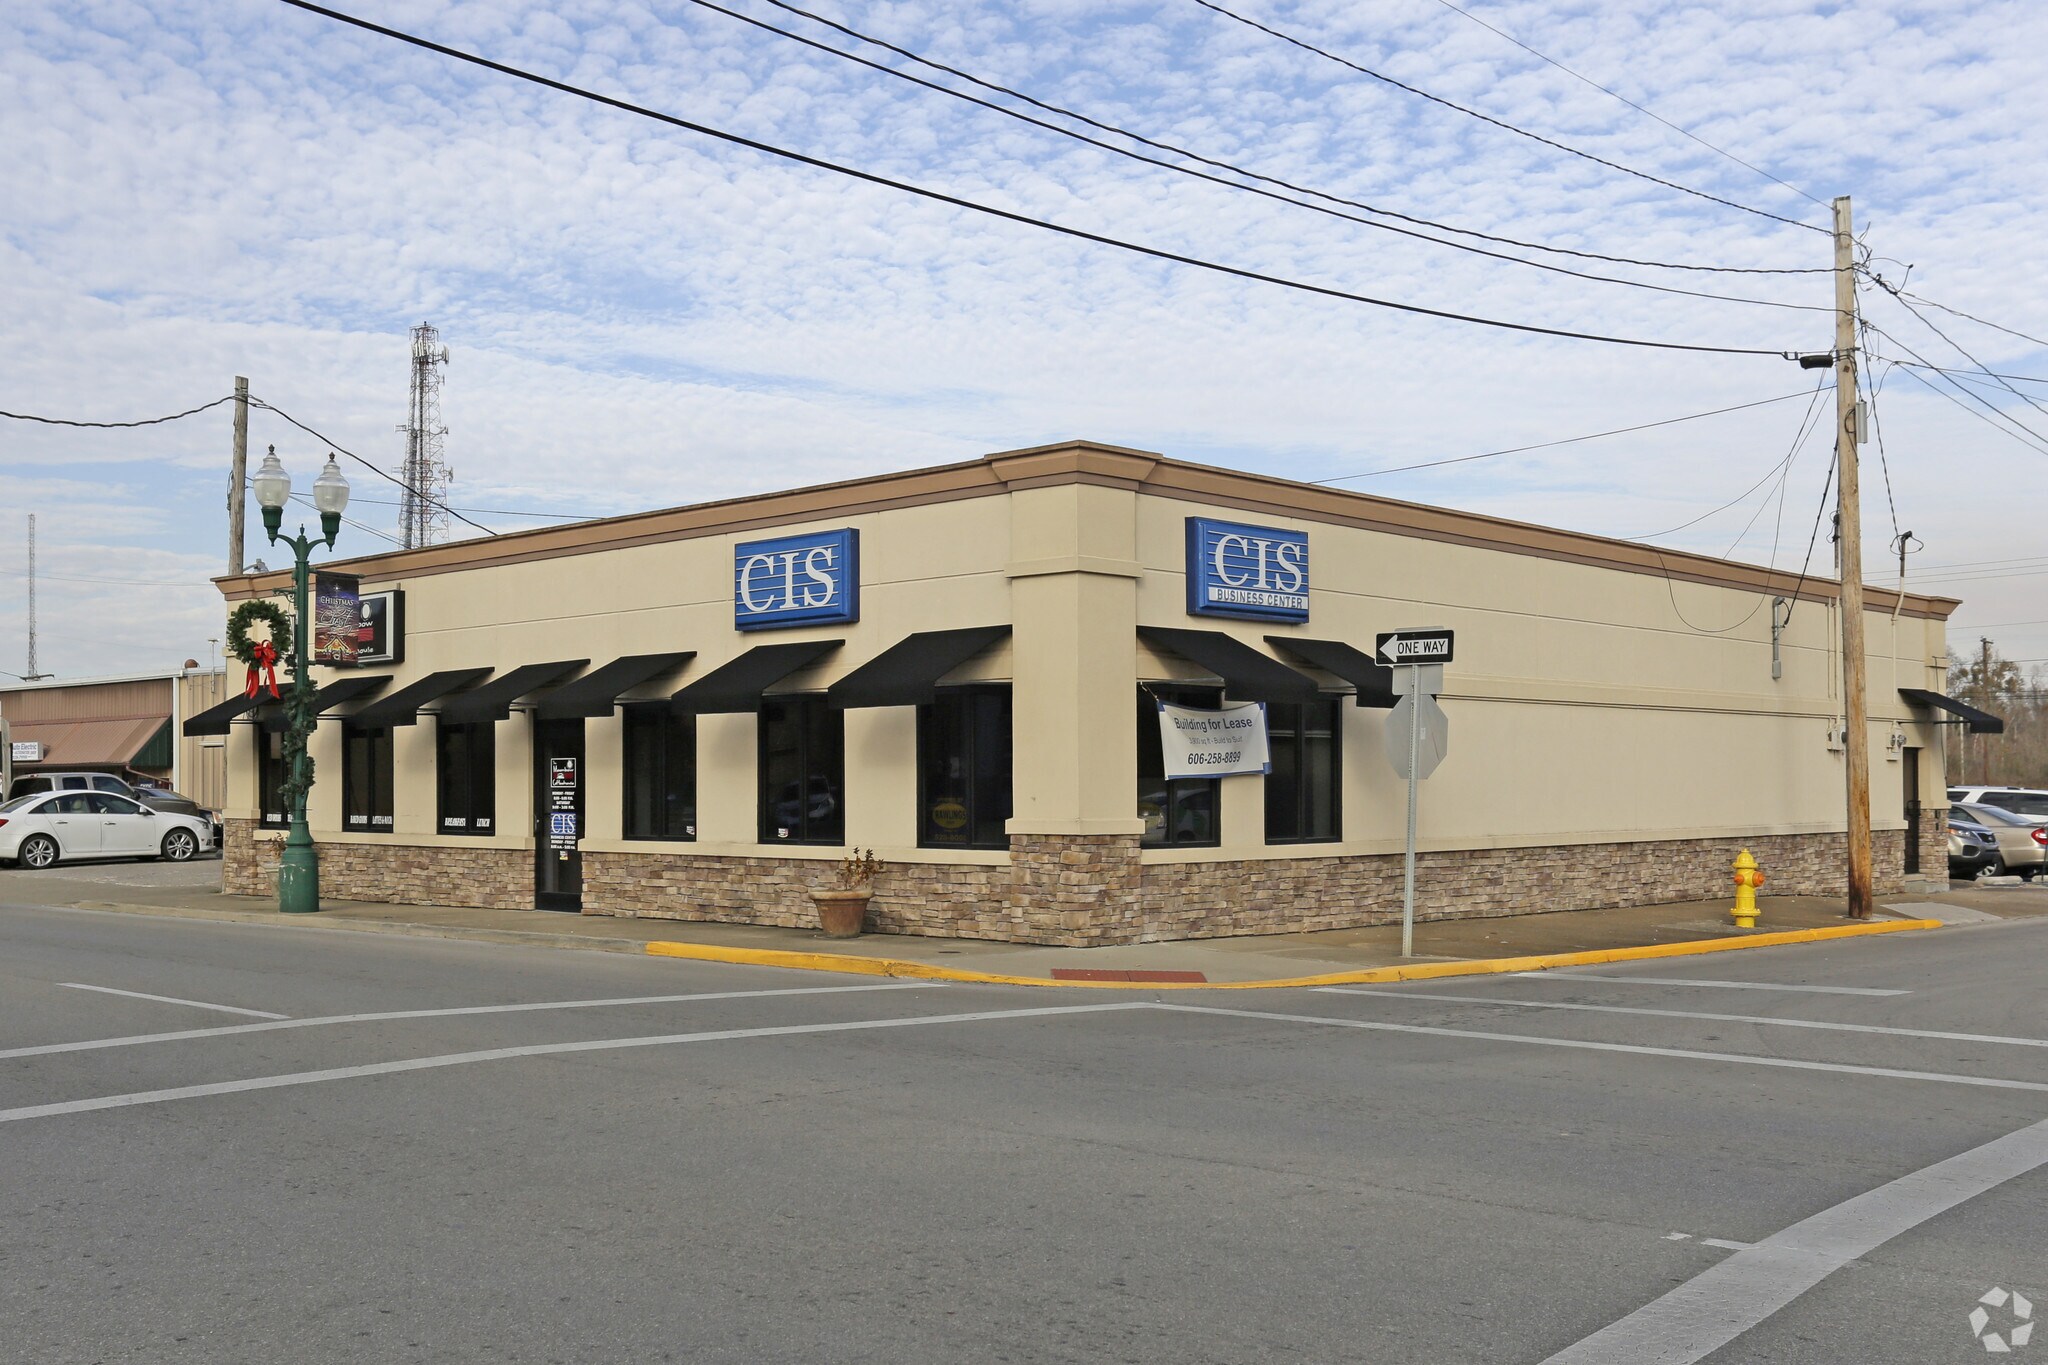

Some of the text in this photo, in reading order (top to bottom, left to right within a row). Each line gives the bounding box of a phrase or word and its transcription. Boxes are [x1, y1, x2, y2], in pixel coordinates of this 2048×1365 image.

[1215, 534, 1302, 593] CIS
[740, 548, 834, 612] CIS
[1217, 588, 1303, 609] BUSINESS CENTER
[1397, 640, 1446, 654] ONE WAY
[1174, 717, 1253, 733] Building for Lease
[1188, 751, 1242, 765] 606-258-8899
[551, 814, 575, 834] CIS
